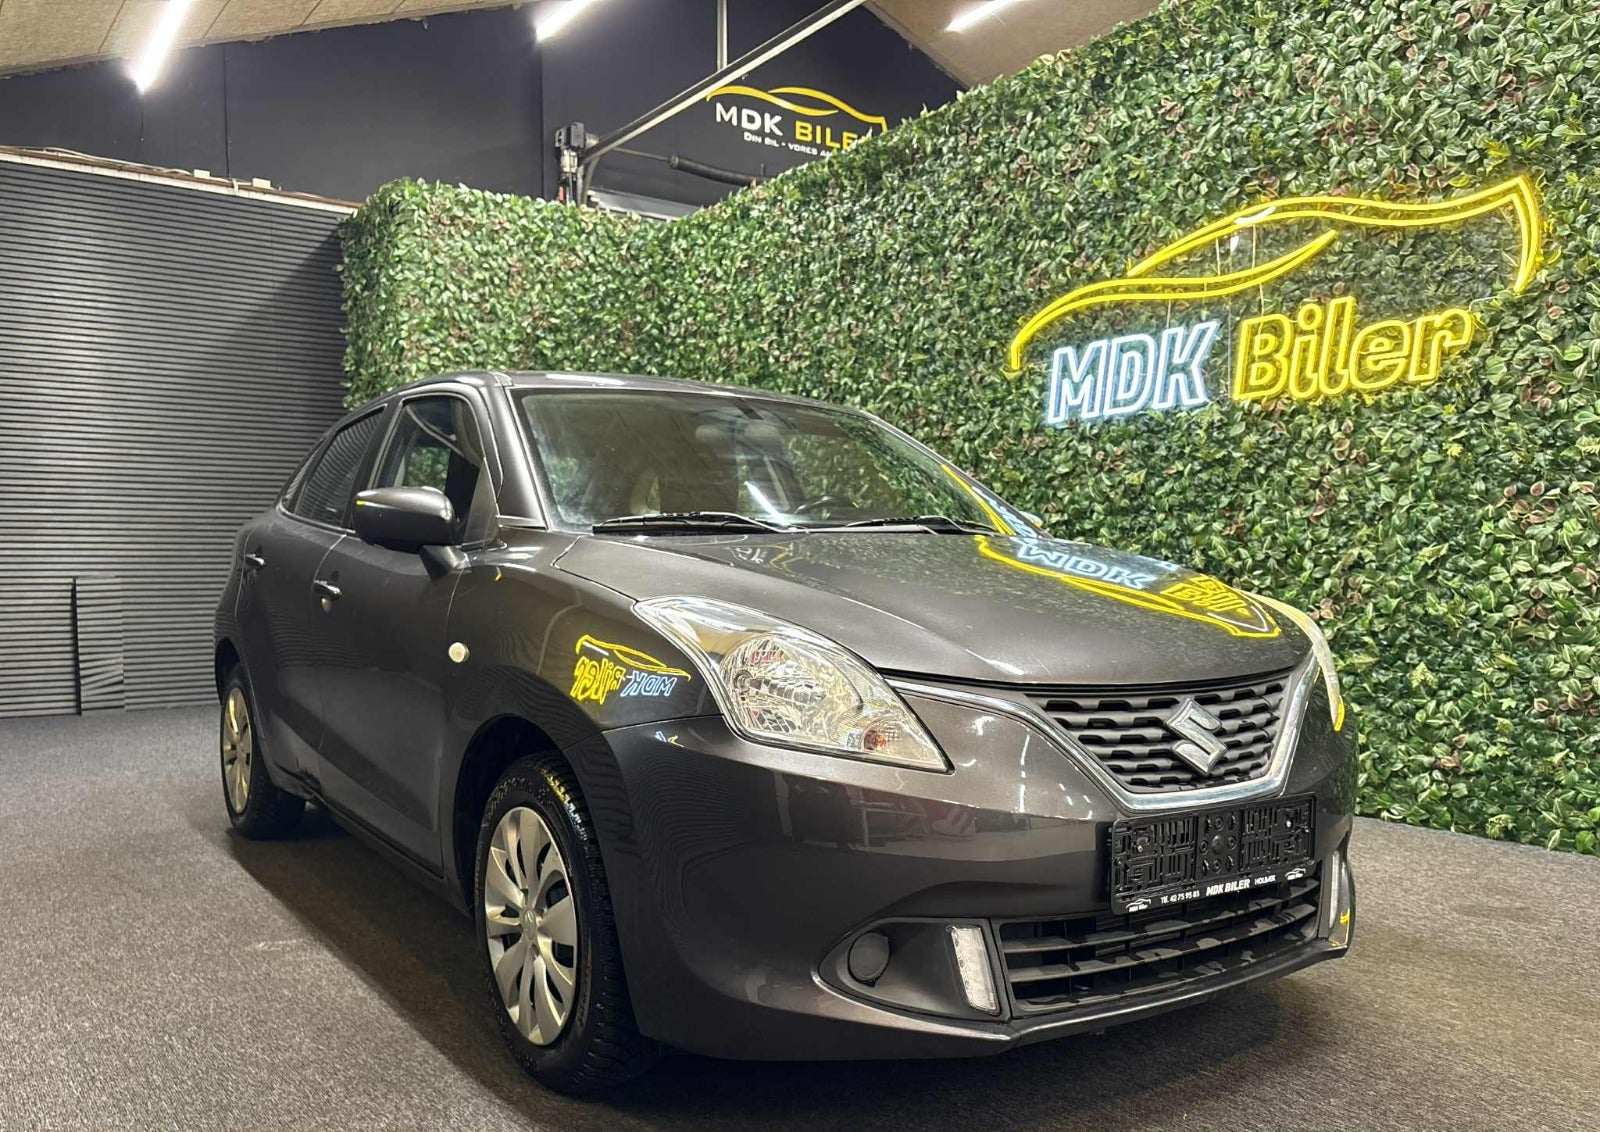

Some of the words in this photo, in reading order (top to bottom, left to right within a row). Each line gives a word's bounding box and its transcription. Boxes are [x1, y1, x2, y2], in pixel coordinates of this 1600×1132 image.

[715, 102, 784, 136] MDK
[795, 120, 868, 150] BILE
[1047, 319, 1220, 424] MDK
[1233, 296, 1474, 400] Biler
[1206, 883, 1224, 896] MDK
[1225, 878, 1250, 892] BILER
